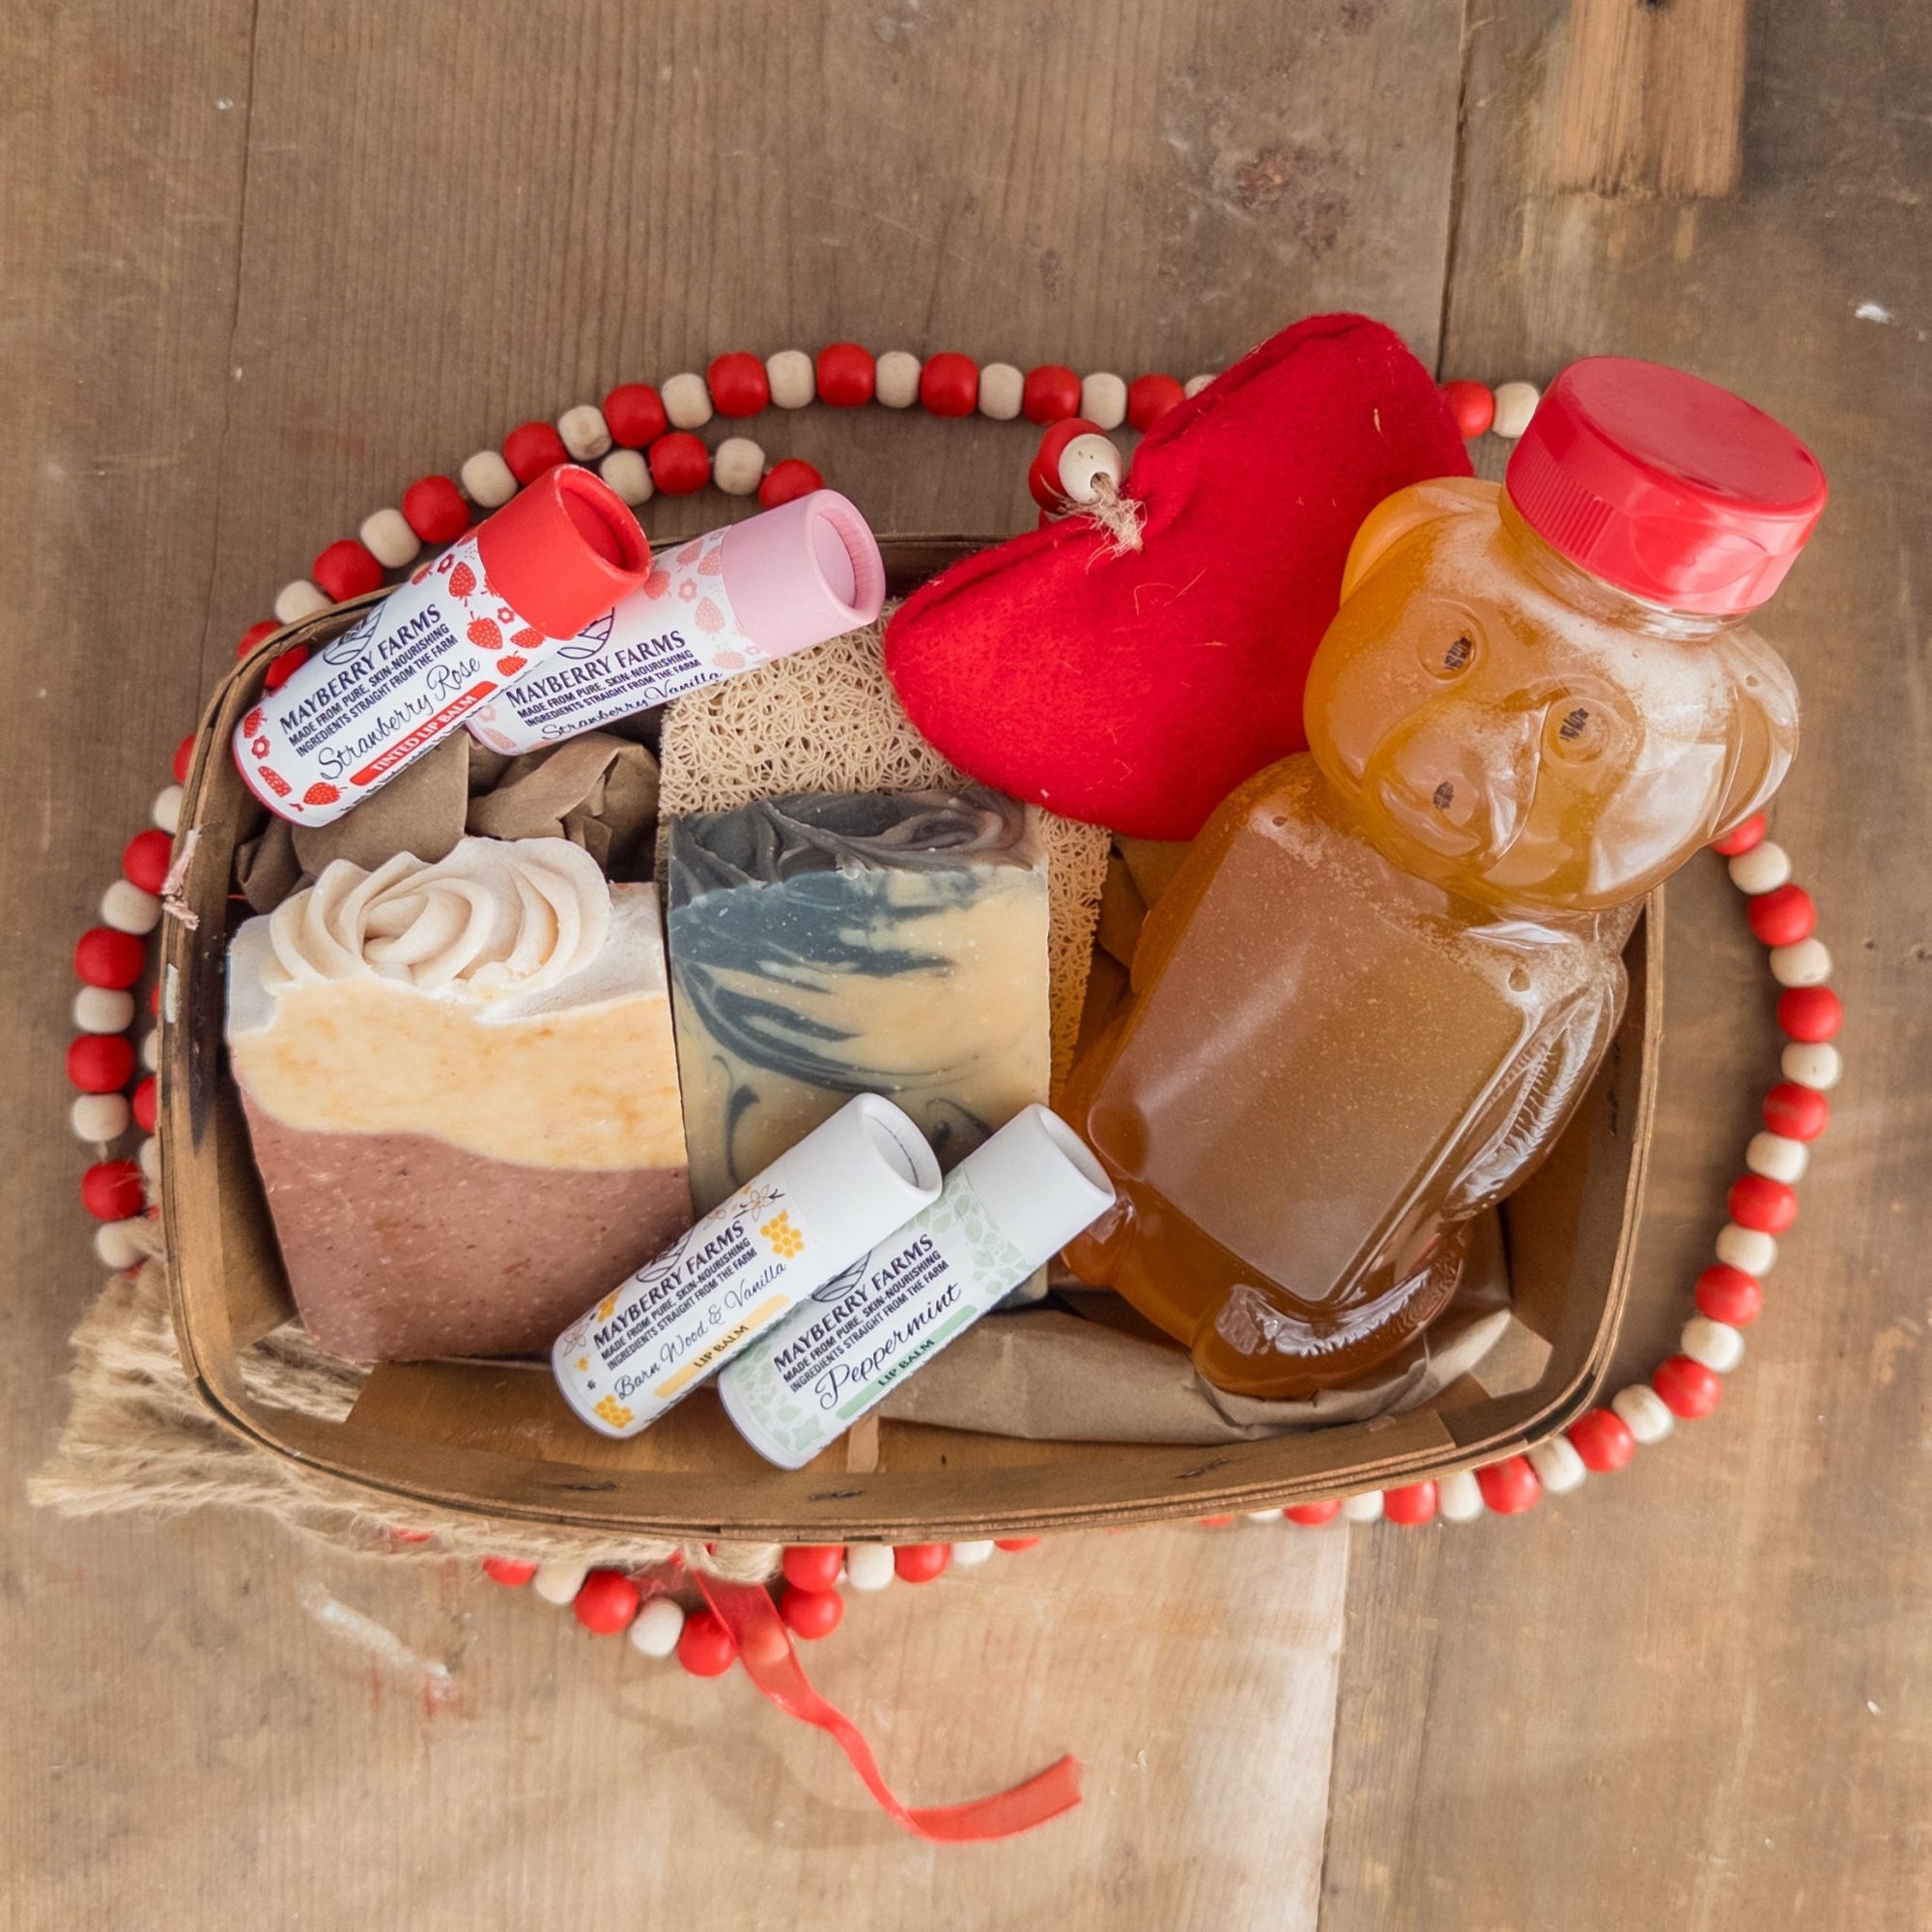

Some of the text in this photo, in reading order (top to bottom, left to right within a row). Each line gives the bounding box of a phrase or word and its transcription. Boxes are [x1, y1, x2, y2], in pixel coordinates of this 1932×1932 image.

[279, 603, 441, 734] MAYBERRY FARMS
[289, 722, 319, 747] MADE
[316, 701, 344, 727] FROM
[368, 623, 450, 689] SKIN-NOURISHING
[297, 635, 459, 757] INGREDIENTS STRAIGHT FROM THE FARM
[319, 694, 434, 781] Strawberry
[427, 656, 480, 700] Rose
[505, 631, 686, 709] MAYBERRY FARMS
[517, 699, 549, 719] MADE
[547, 691, 578, 710] FROM
[605, 649, 695, 689] SKIN-NOURISHING
[525, 659, 702, 727] INGREDIENTS STRAIGHT FROM THE FARM
[542, 671, 723, 742] Strawberry Vanilla
[372, 695, 479, 776] TINTED LIP BALM
[592, 1220, 745, 1350] MAYBERRY FARMS
[601, 1337, 627, 1361] MADE
[626, 1318, 652, 1341] FROM
[676, 1237, 752, 1301] SKIN-NOURISHING
[607, 1248, 757, 1370] INGREDIENTS STRAIGHT FROM THE FARM
[614, 1361, 661, 1400] Barn
[660, 1323, 708, 1364] Wood
[709, 1304, 724, 1325] &
[724, 1263, 787, 1312] Vanilla
[693, 1323, 750, 1369] LIP BALM
[773, 1233, 934, 1372] MAYBERRY FARMS
[782, 1358, 812, 1383] MADE
[810, 1336, 837, 1362] FROM
[864, 1250, 941, 1318] SKIN-NOURISHING
[789, 1262, 951, 1393] INGREDIENTS STRAIGHT FROM THE FARM
[814, 1282, 962, 1410] Peppermint
[877, 1339, 935, 1387] LIP BALM
